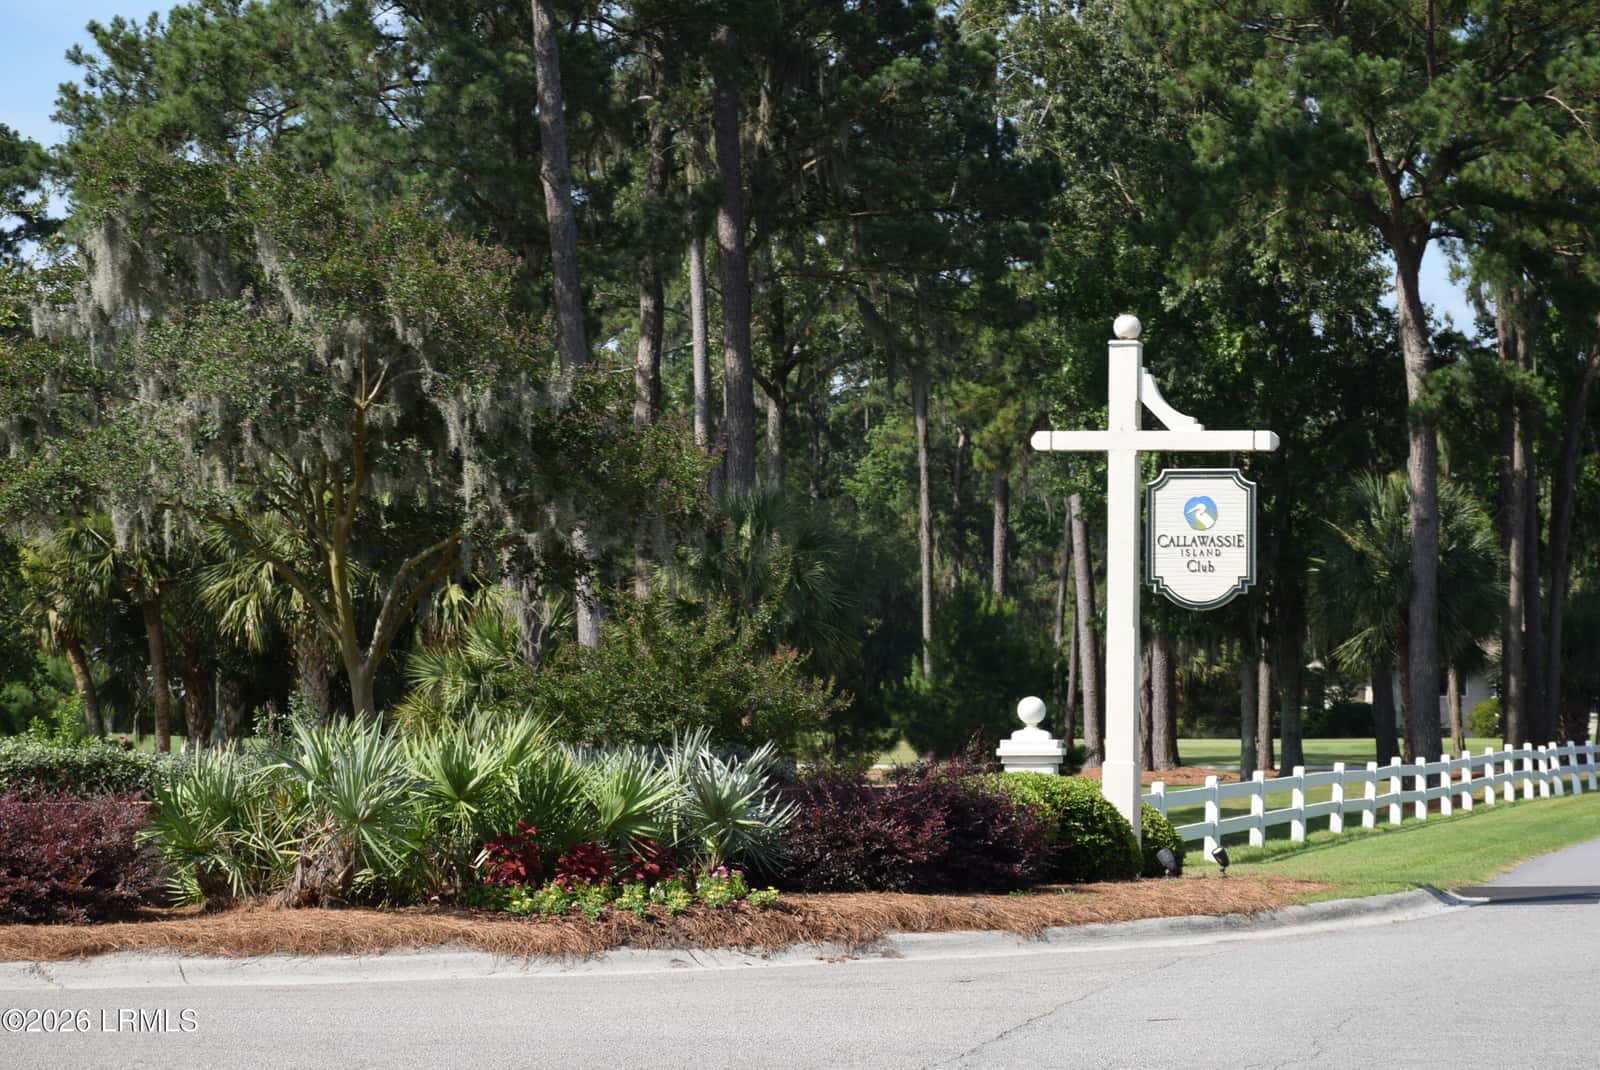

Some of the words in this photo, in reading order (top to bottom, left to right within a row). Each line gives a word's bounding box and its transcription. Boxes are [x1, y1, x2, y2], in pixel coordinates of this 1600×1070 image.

[1157, 534, 1245, 548] CALLAWASSIE
[1181, 549, 1222, 557] ISLAND
[1186, 560, 1215, 573] Club
